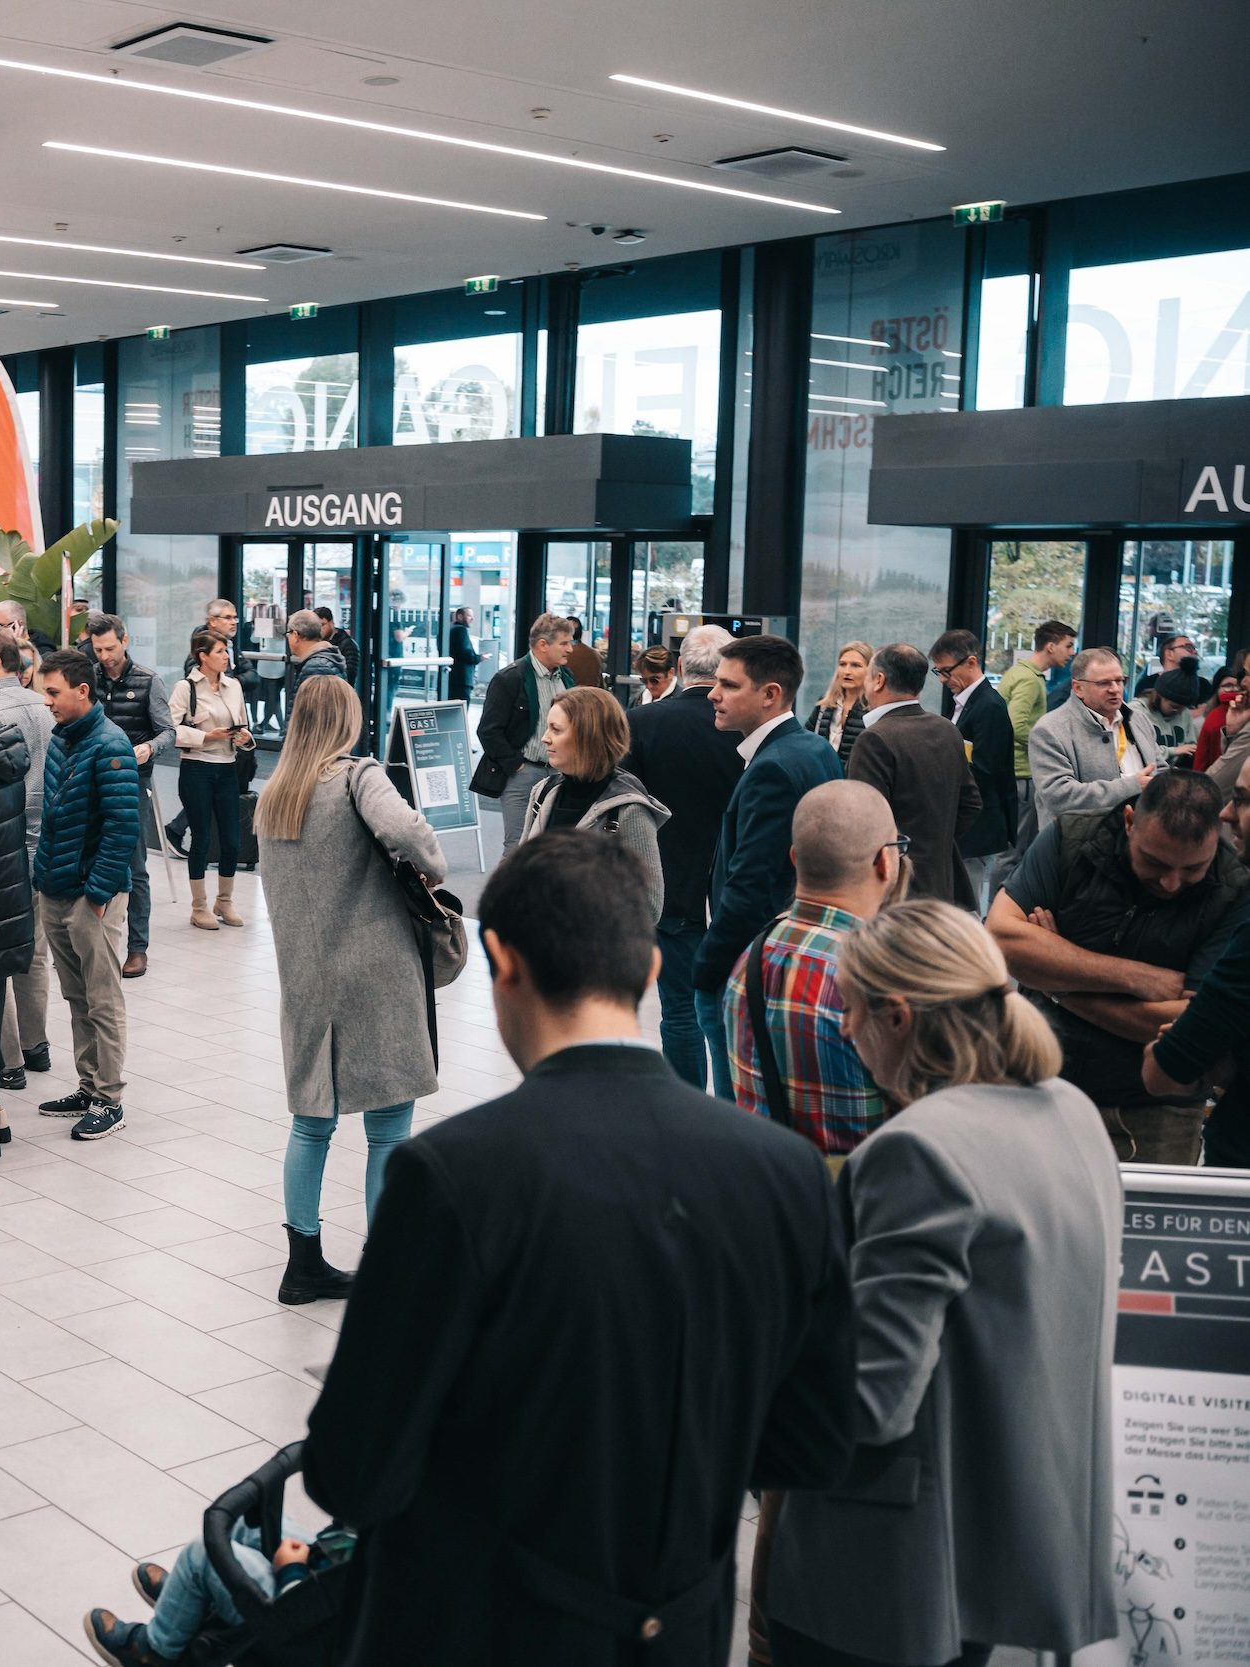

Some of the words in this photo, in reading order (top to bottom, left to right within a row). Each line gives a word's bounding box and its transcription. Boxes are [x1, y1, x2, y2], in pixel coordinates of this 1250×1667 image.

[265, 492, 403, 527] AUSGANG
[732, 620, 741, 632] P
[409, 719, 434, 729] GAST
[456, 742, 470, 812] HIGHLIGHTS
[1163, 1213, 1202, 1232] FÜR
[1121, 1250, 1250, 1287] AST
[1123, 1390, 1196, 1407] DIGITALE
[1167, 1421, 1184, 1432] Sie
